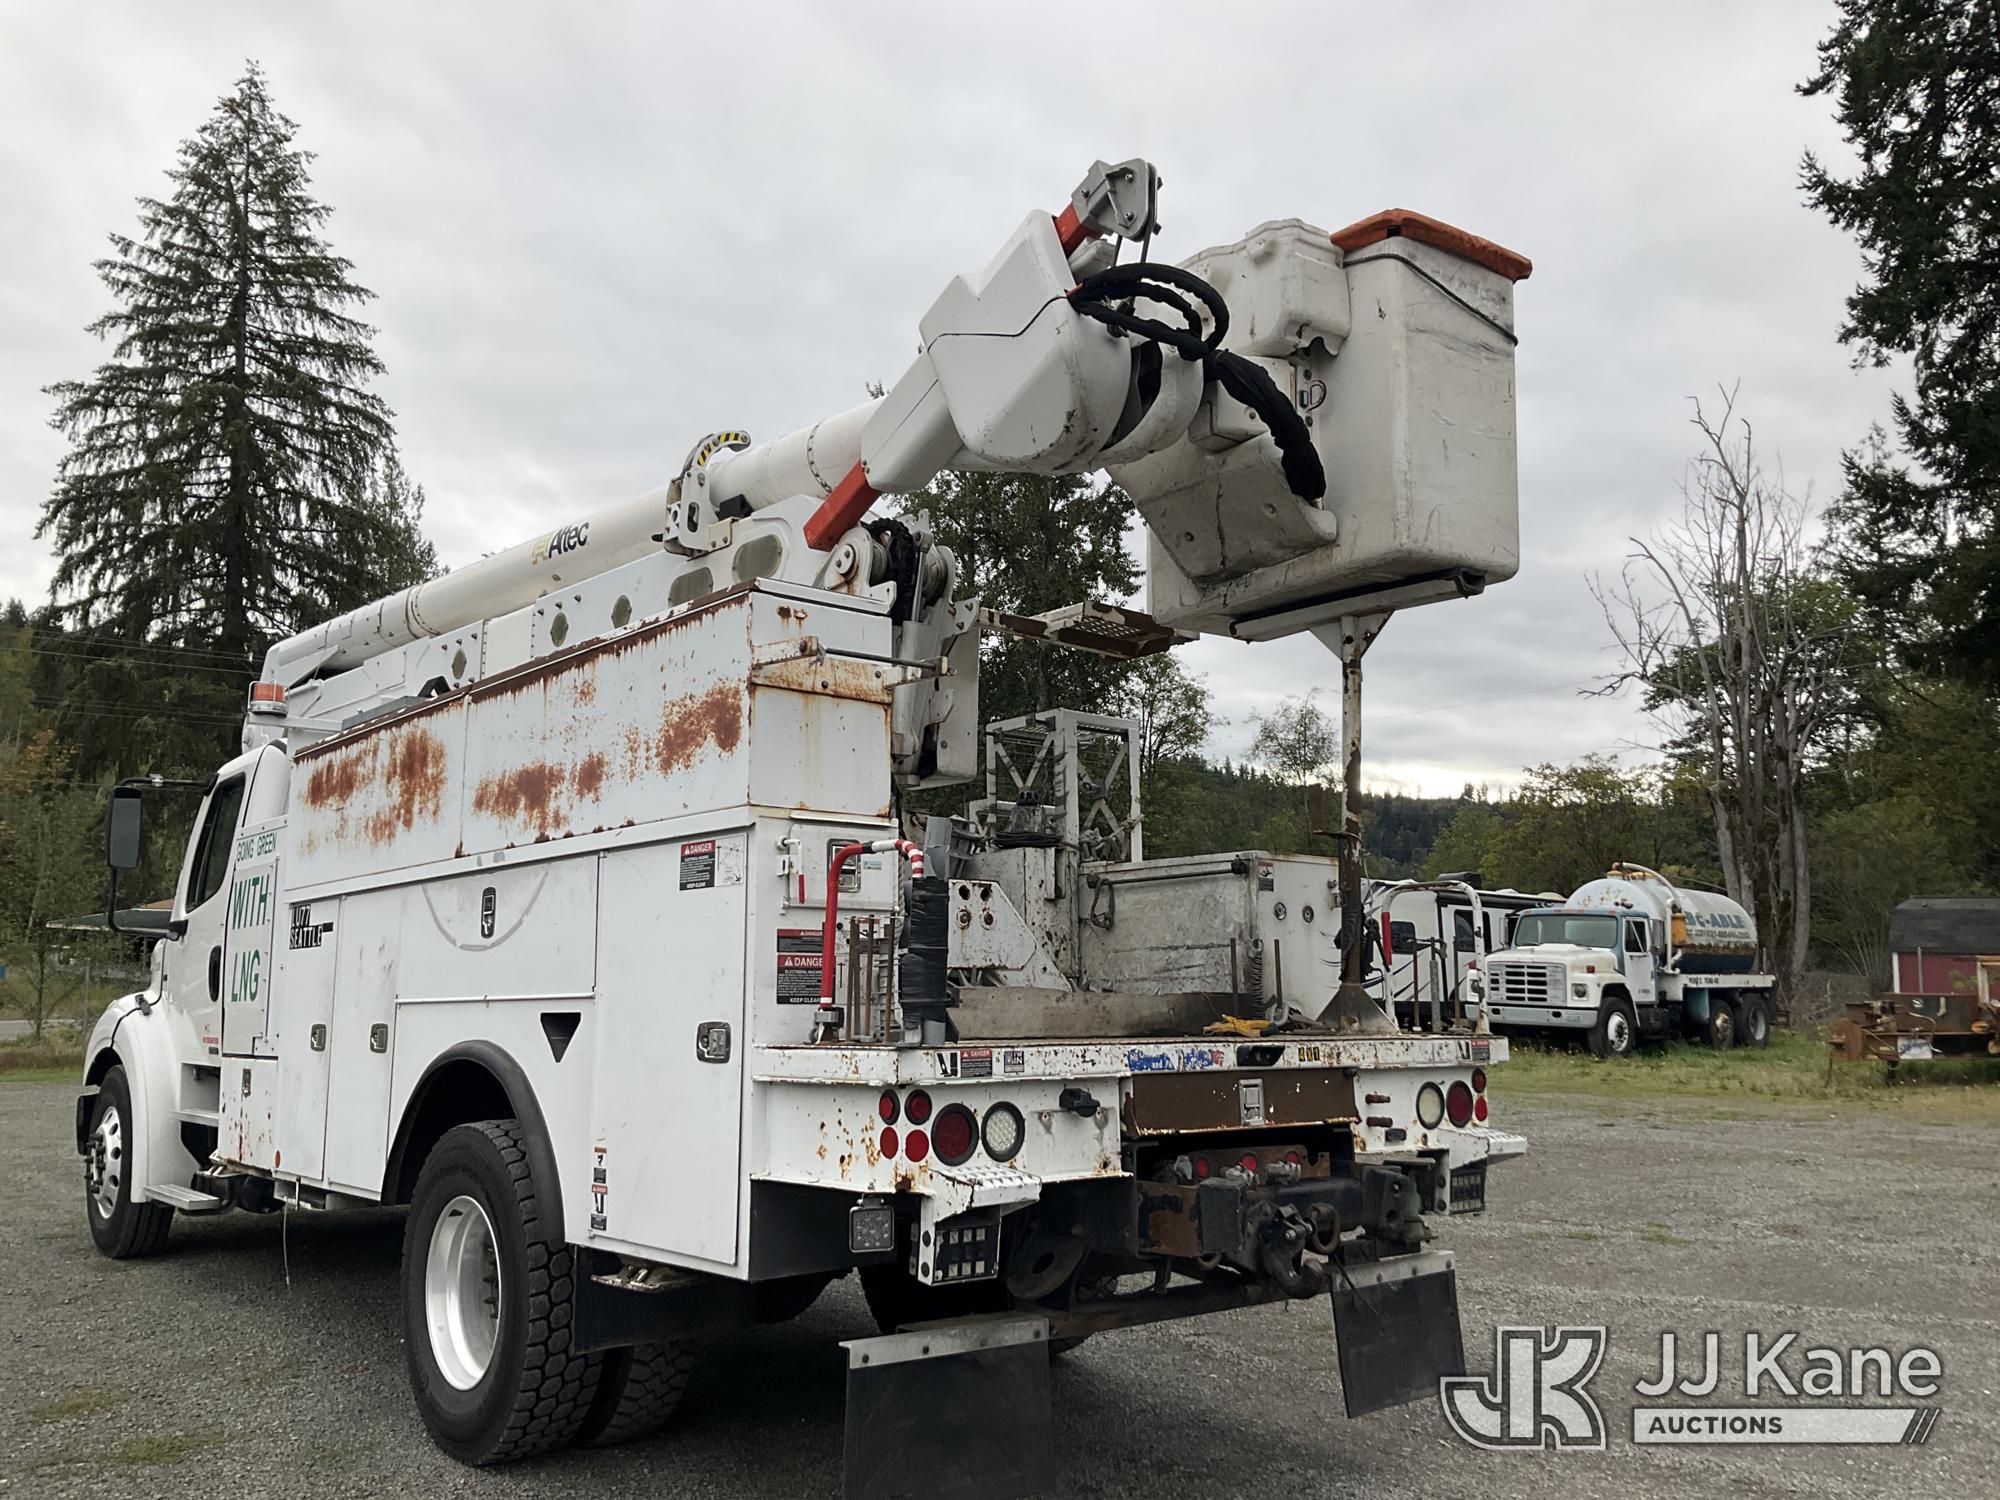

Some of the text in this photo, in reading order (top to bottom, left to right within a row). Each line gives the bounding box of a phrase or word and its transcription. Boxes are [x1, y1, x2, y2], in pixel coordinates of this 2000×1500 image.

[237, 833, 277, 862] GOING GREEN
[232, 874, 270, 930] WITH
[290, 926, 322, 948] SEATTLE
[231, 949, 261, 1002] LNG
[794, 957, 823, 967] DANGE
